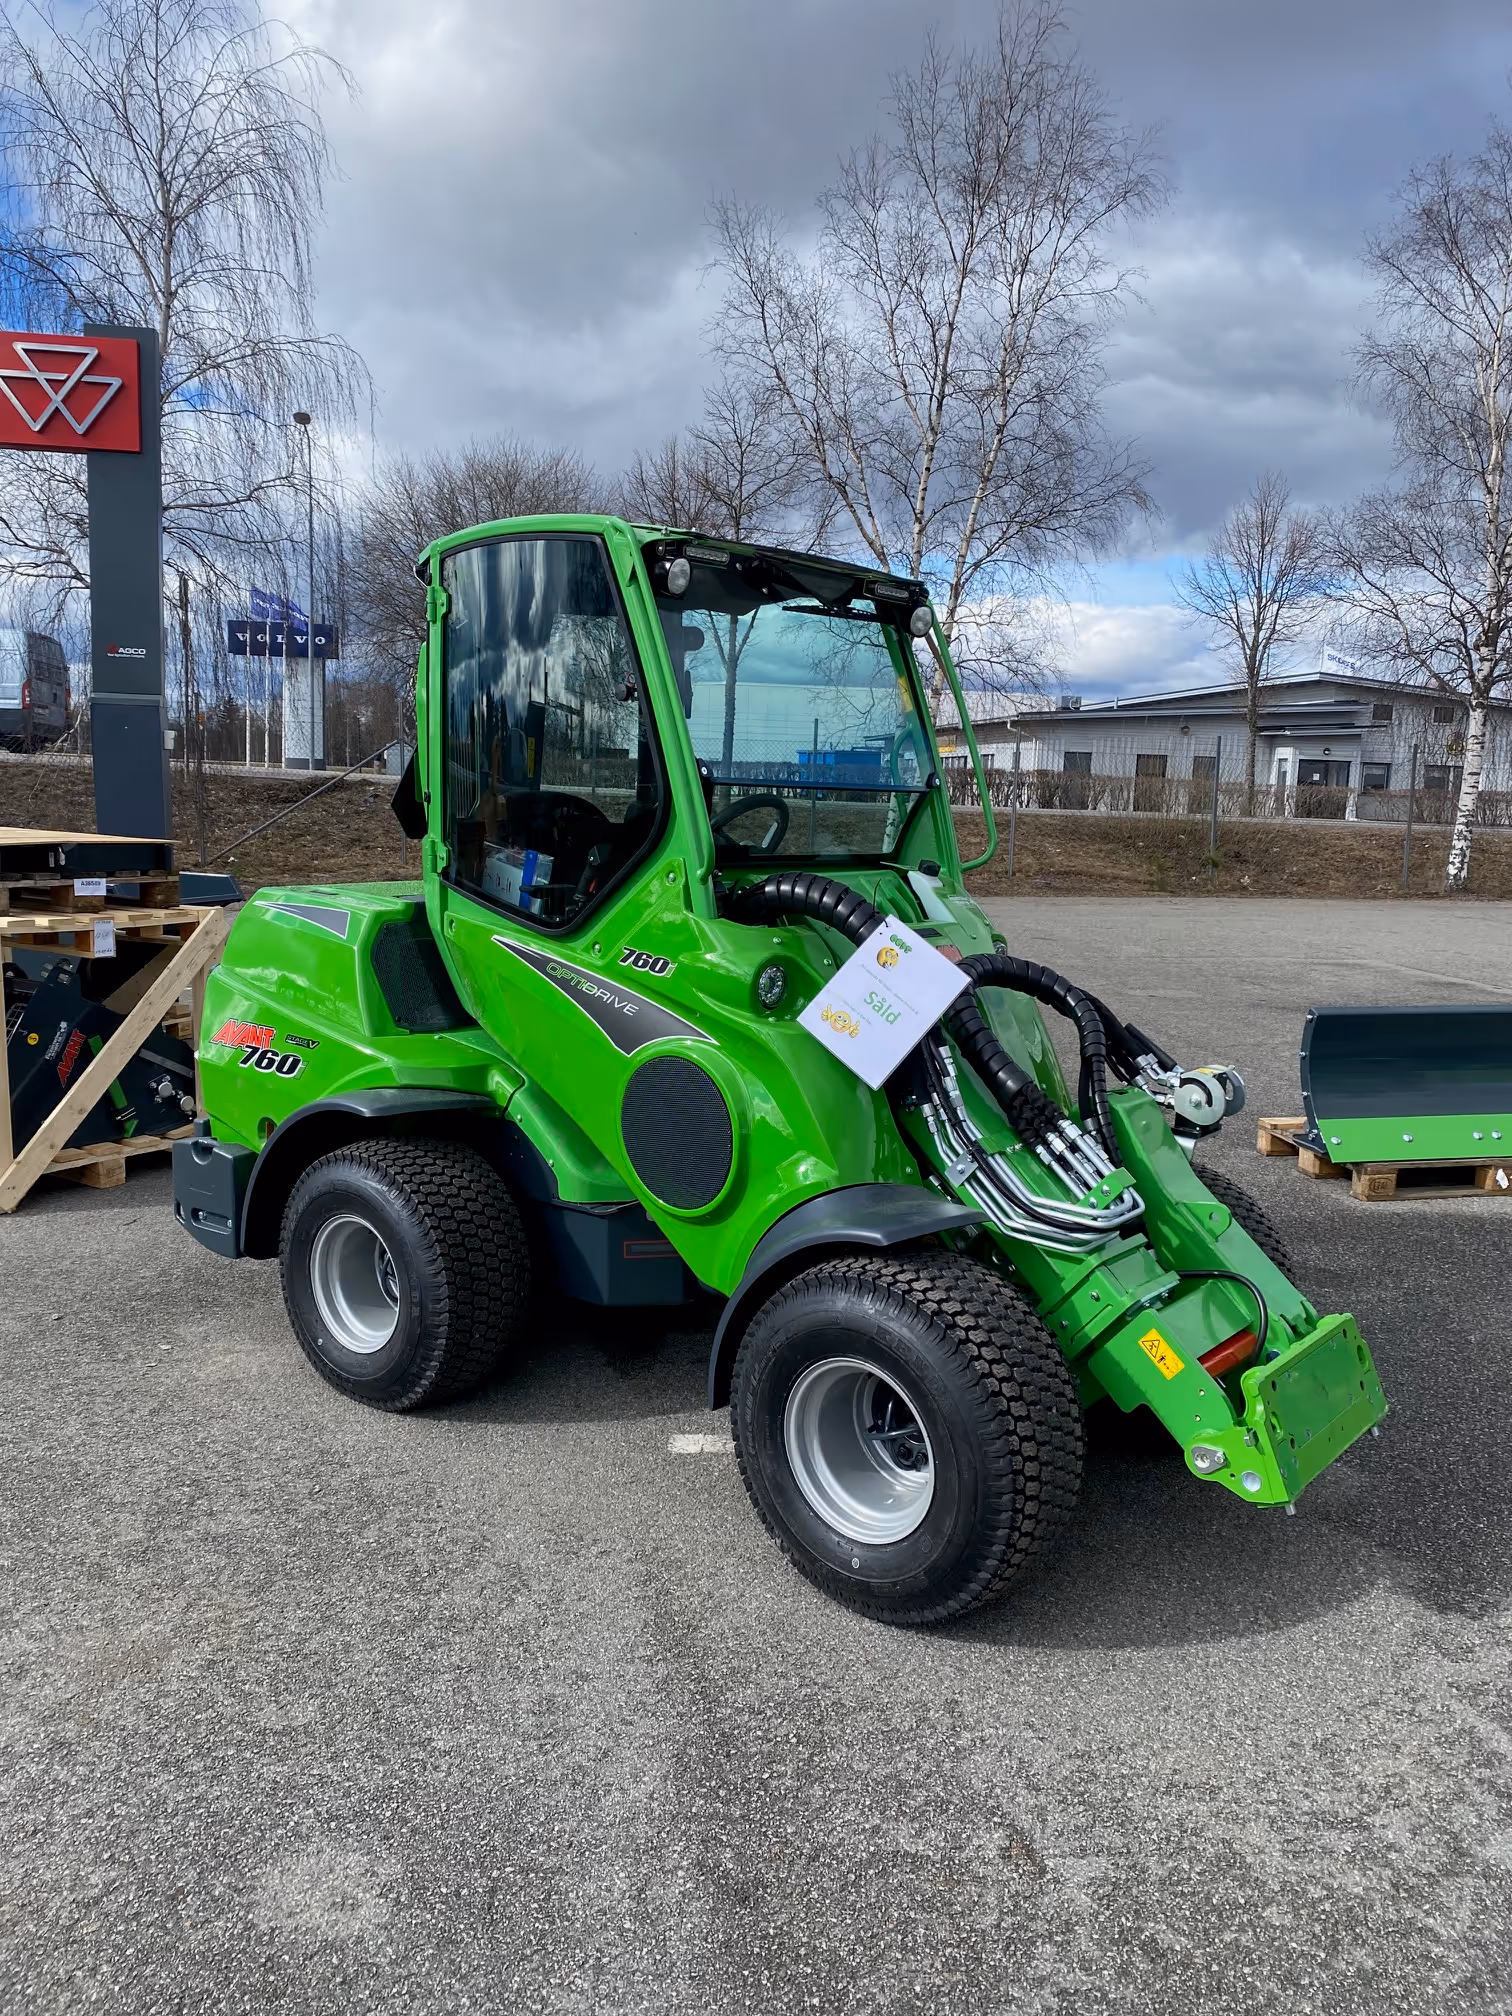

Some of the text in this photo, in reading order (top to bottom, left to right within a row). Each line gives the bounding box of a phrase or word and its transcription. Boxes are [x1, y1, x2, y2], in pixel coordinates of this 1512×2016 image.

[118, 647, 146, 655] AGCO
[235, 633, 326, 645] VOLVO
[545, 962, 639, 1016] OPTIDRIVE
[863, 990, 902, 1026] Såld
[209, 1018, 276, 1050] AVANT
[57, 1028, 87, 1089] AVANT
